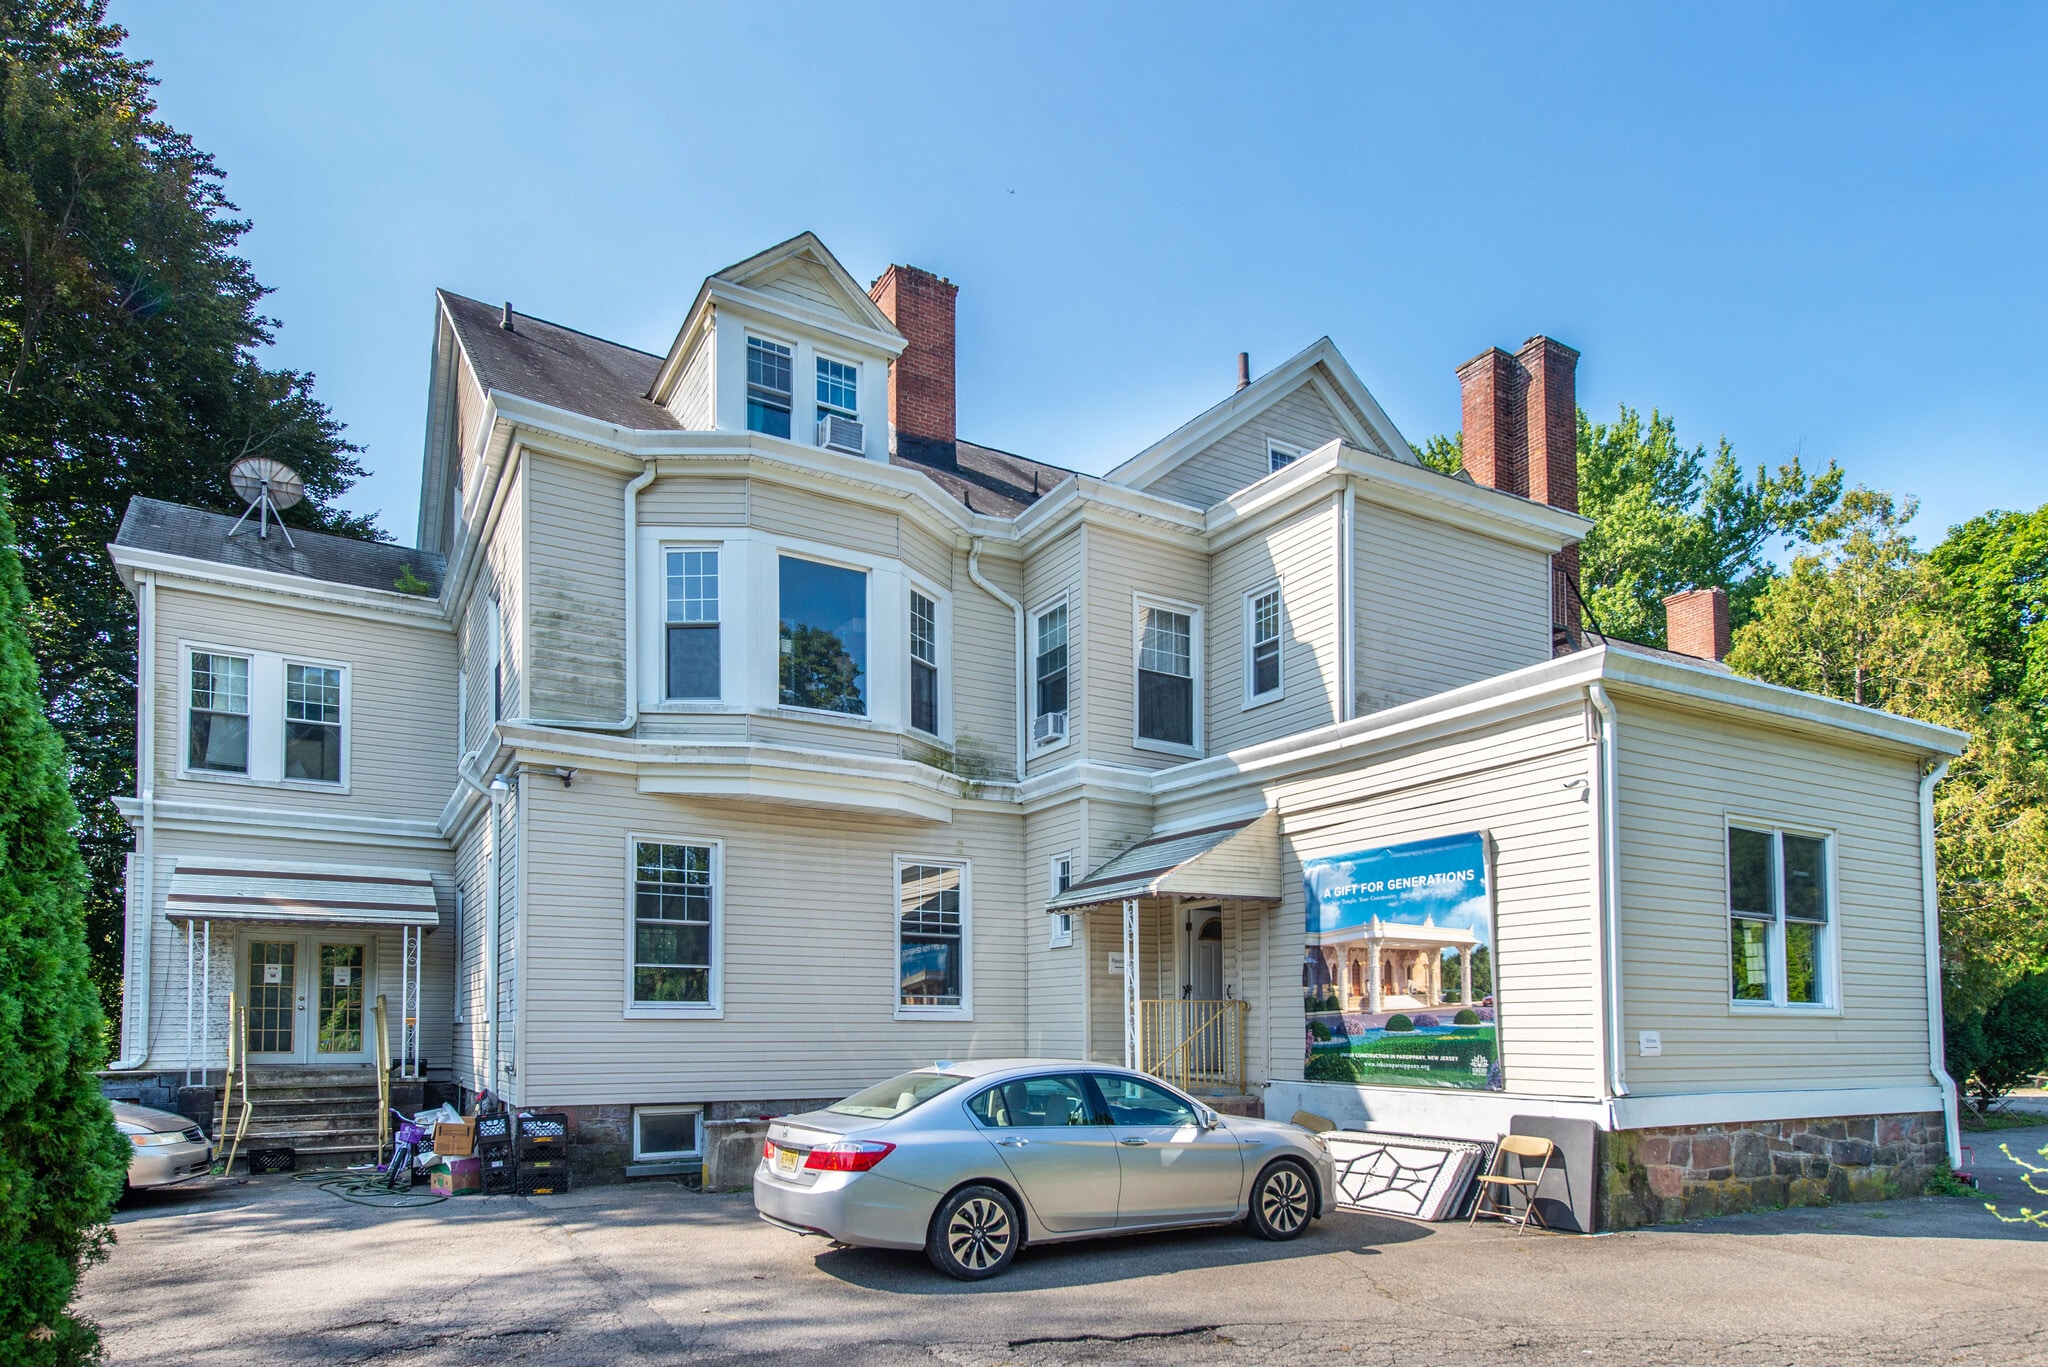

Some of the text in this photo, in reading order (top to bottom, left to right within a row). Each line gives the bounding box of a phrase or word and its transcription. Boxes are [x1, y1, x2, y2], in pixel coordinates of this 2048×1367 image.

[1323, 869, 1475, 898] A GIFT FOR GENERATIONS
